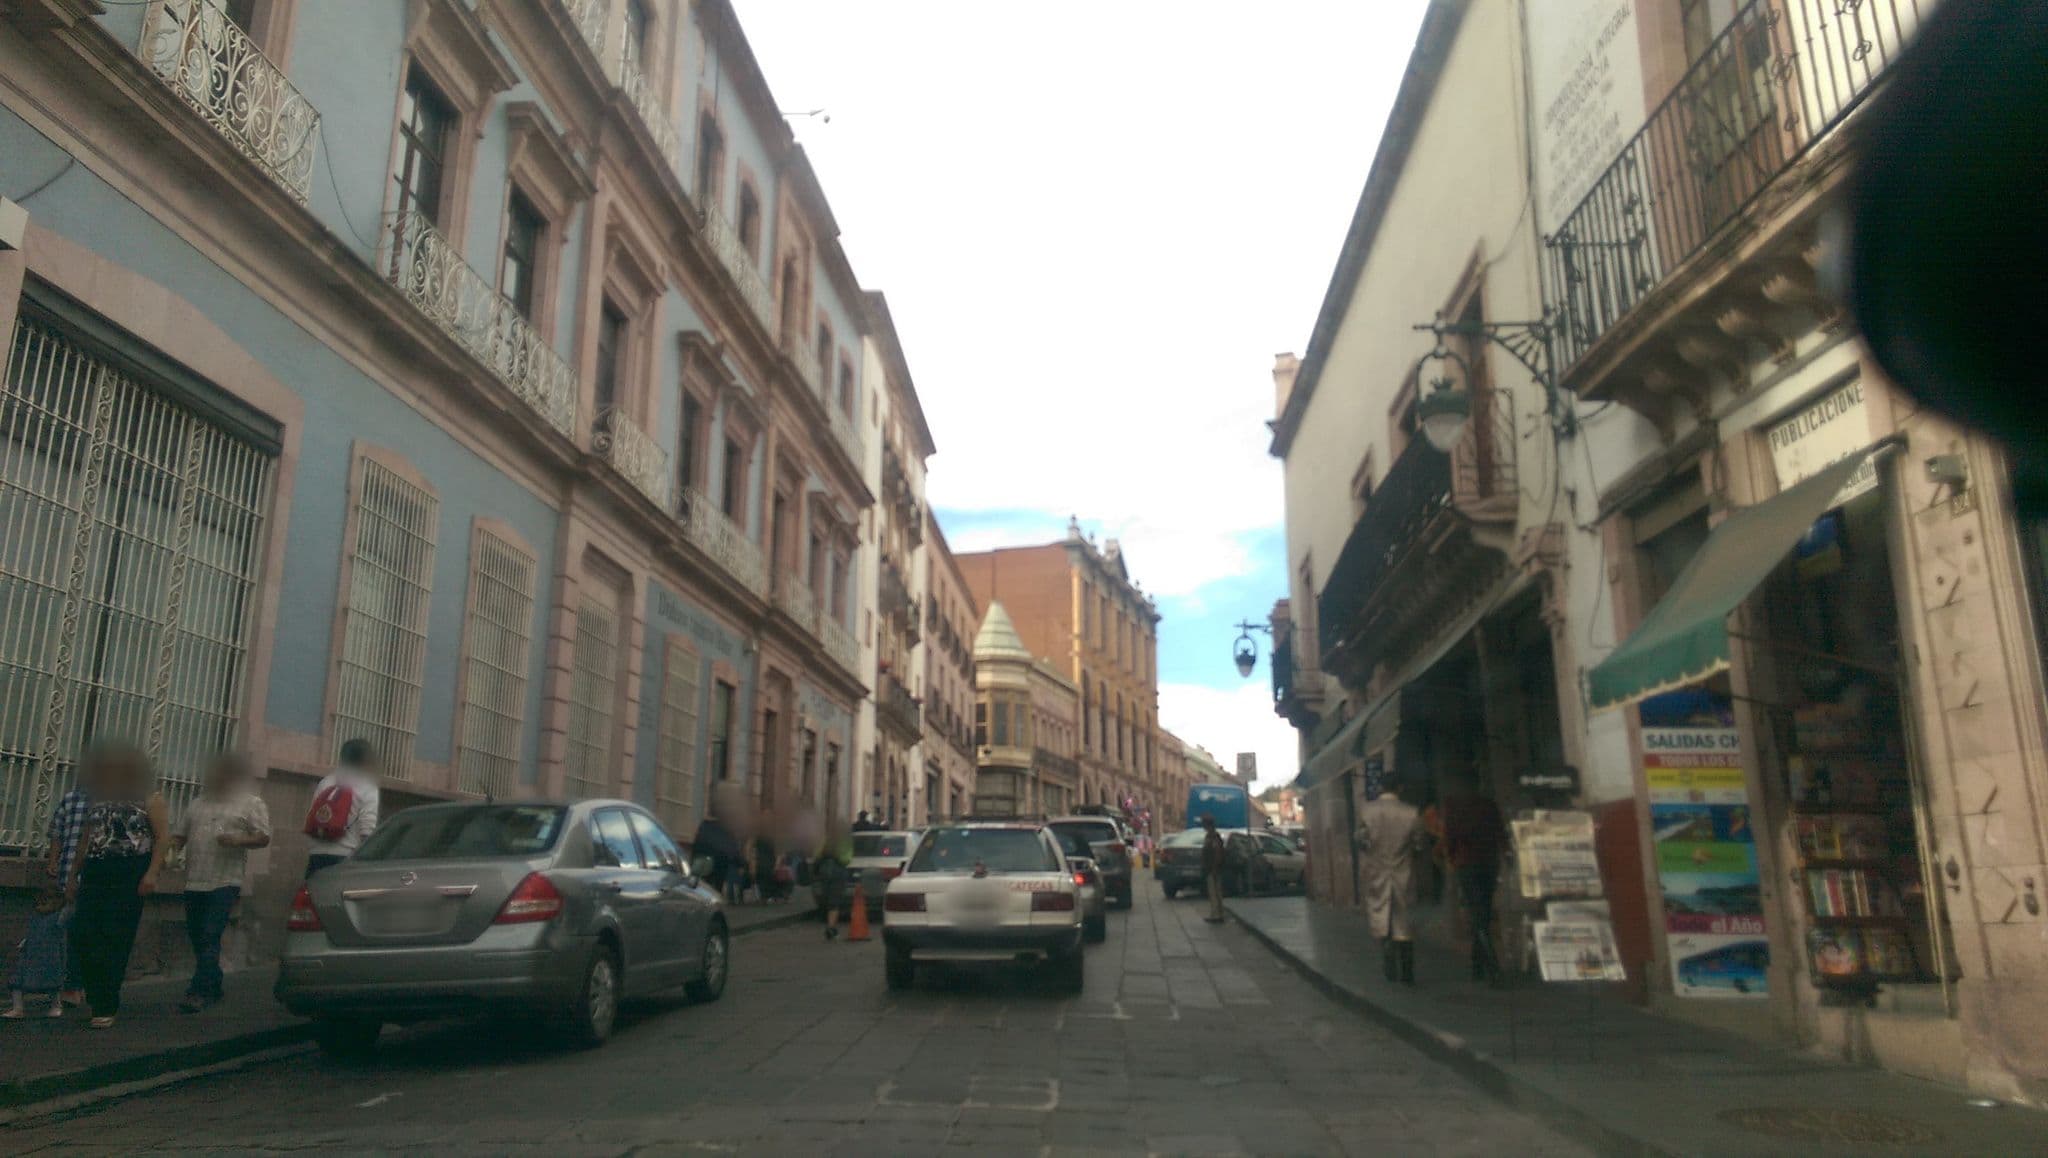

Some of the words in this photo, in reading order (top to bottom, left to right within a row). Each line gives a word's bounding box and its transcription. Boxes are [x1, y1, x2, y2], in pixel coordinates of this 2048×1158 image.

[1646, 733, 1715, 750] SALIDAS
[1711, 917, 1728, 932] el
[1731, 916, 1762, 933] Año
